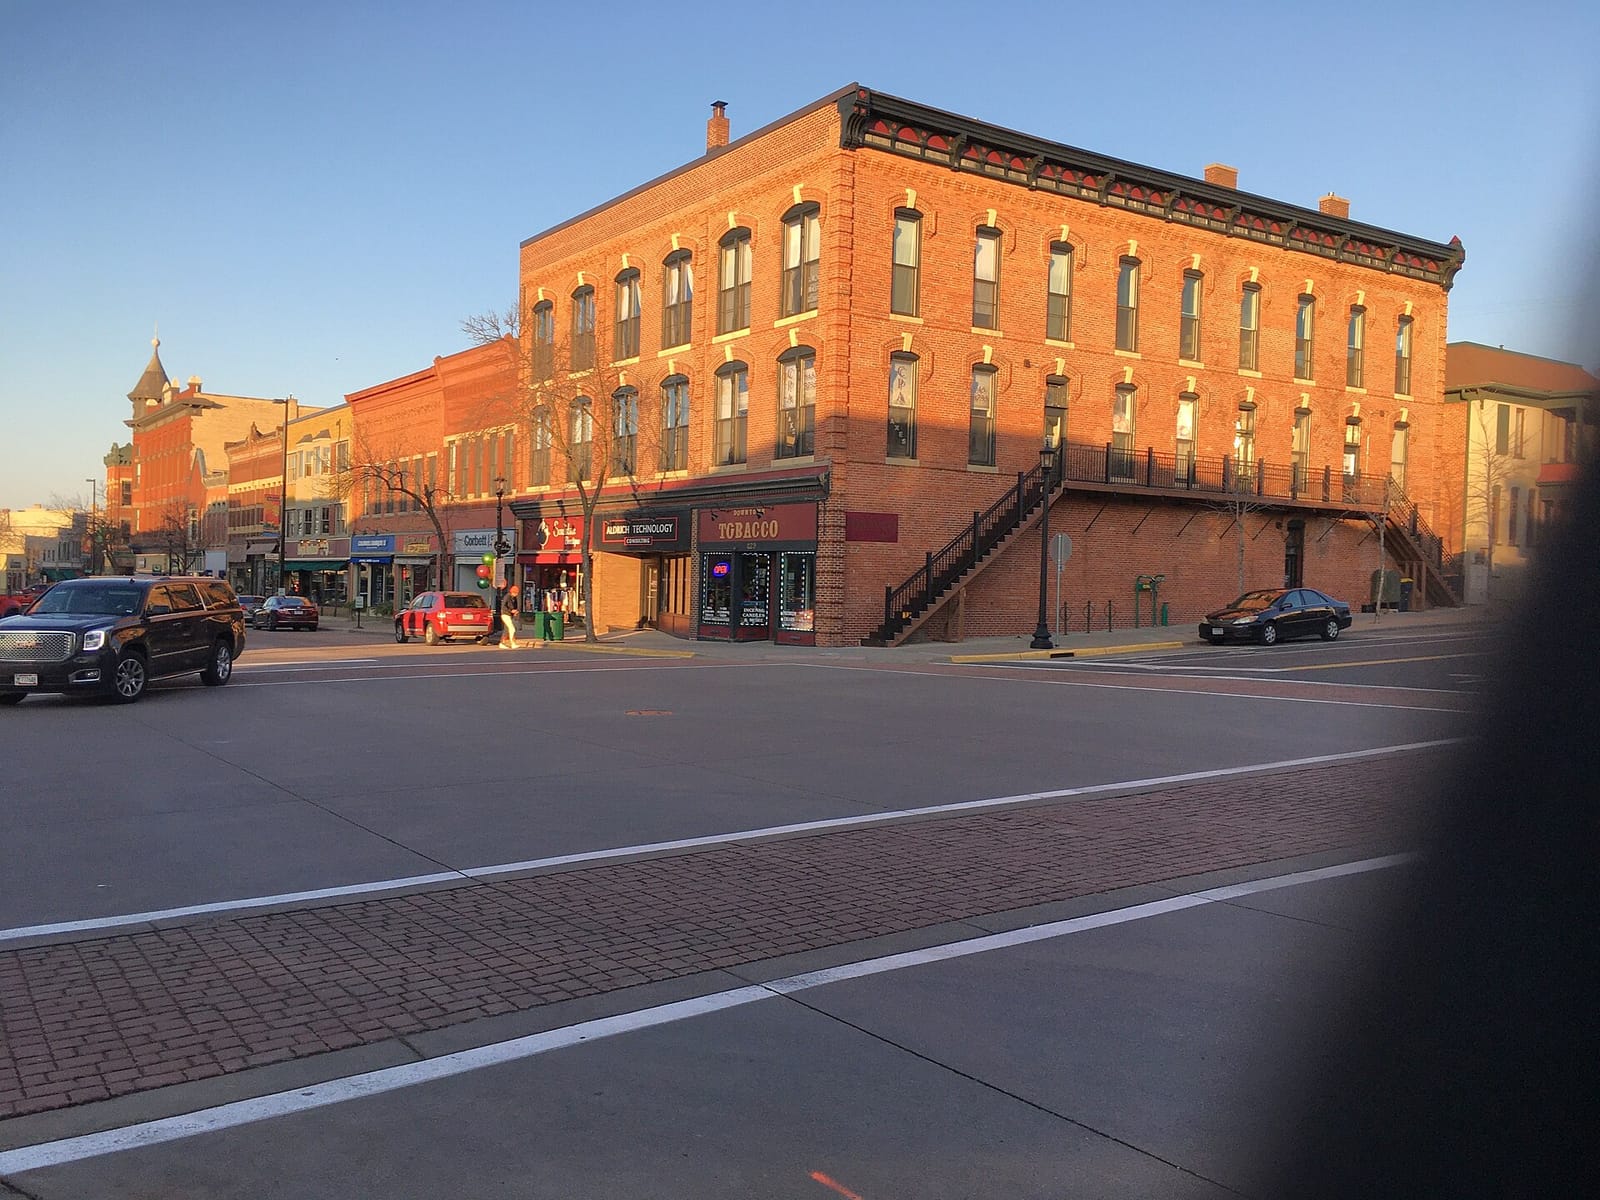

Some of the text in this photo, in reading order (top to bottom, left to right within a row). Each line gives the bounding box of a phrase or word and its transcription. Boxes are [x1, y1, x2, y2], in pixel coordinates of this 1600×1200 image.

[896, 366, 906, 405] CPA
[606, 523, 673, 535] ALDRICH TECHNOLOGY
[718, 520, 779, 539] TOBACCO
